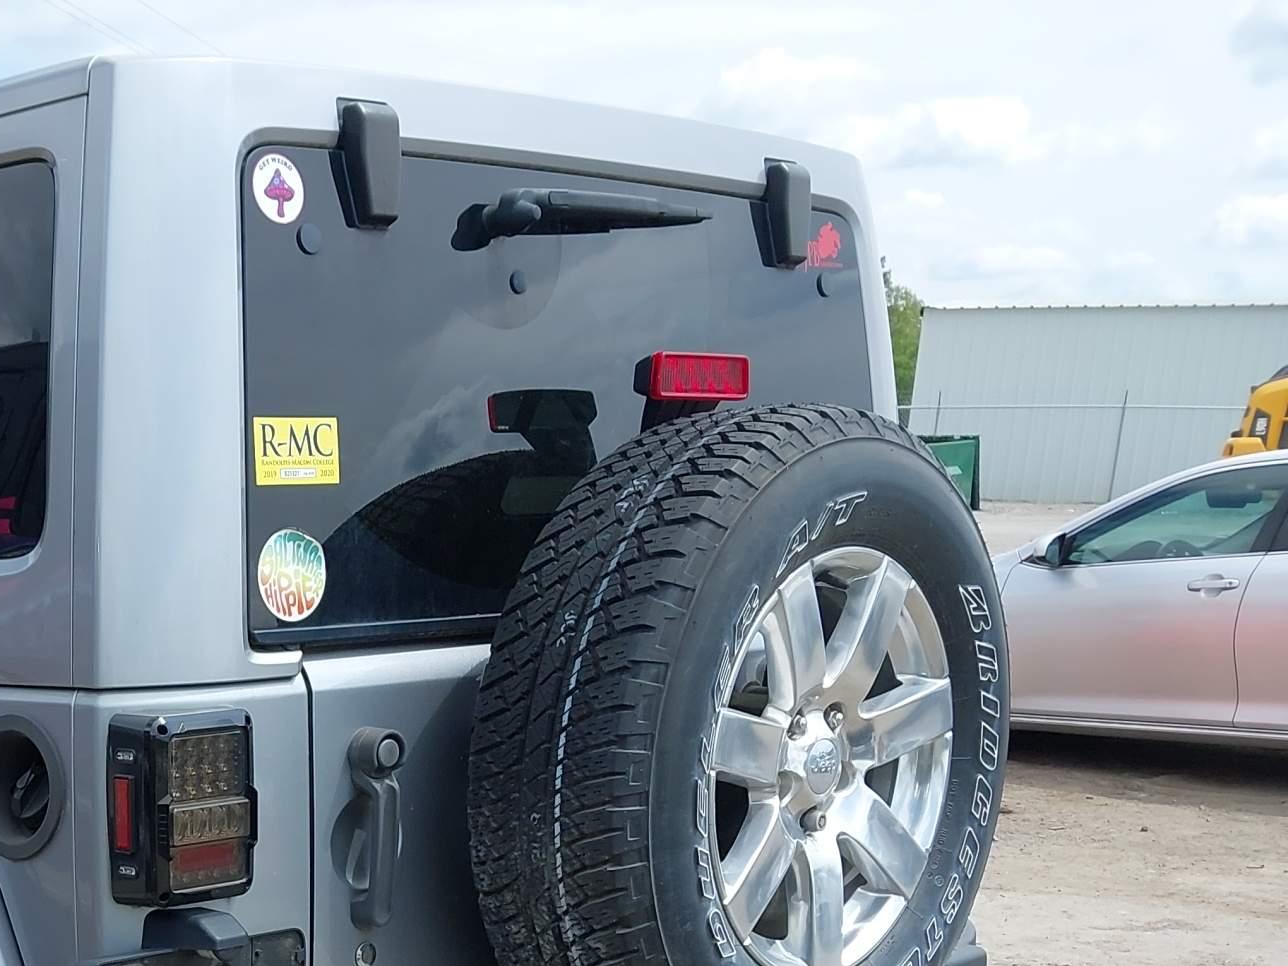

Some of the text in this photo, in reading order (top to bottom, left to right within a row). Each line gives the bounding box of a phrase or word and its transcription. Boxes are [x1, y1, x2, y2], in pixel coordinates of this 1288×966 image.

[271, 157, 293, 171] WEIRD
[259, 423, 334, 458] R-MC
[775, 491, 868, 578] A/T
